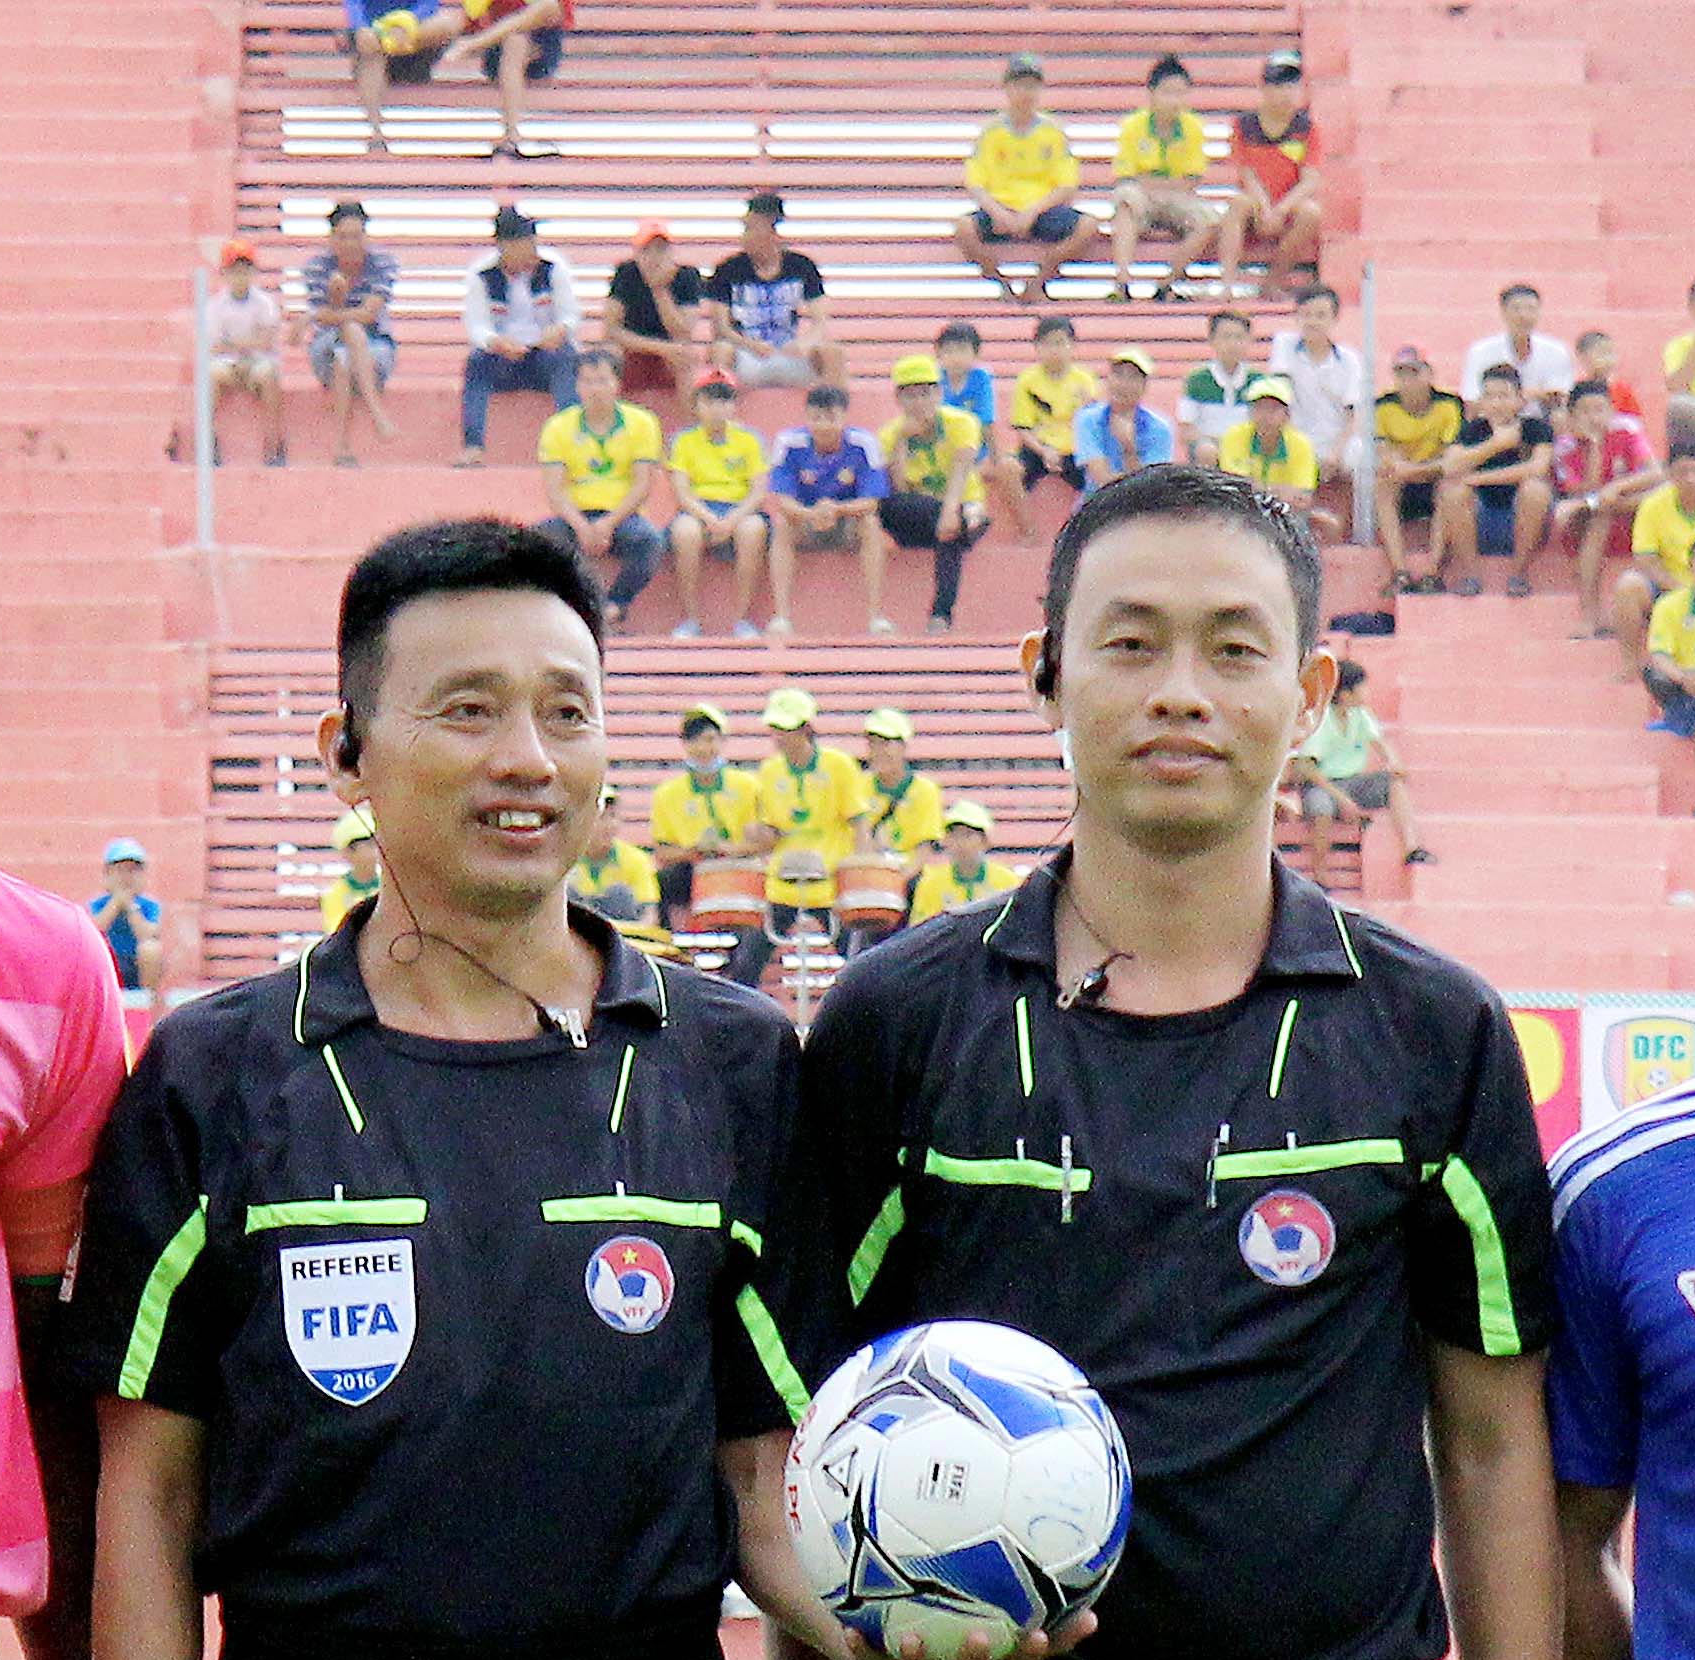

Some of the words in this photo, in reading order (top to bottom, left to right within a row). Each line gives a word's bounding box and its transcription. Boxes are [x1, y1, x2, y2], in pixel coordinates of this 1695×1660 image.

[1633, 1035, 1686, 1061] DFC
[291, 1253, 403, 1281] REFEREE
[302, 1303, 399, 1340] FIFA
[332, 1372, 378, 1393] 2016
